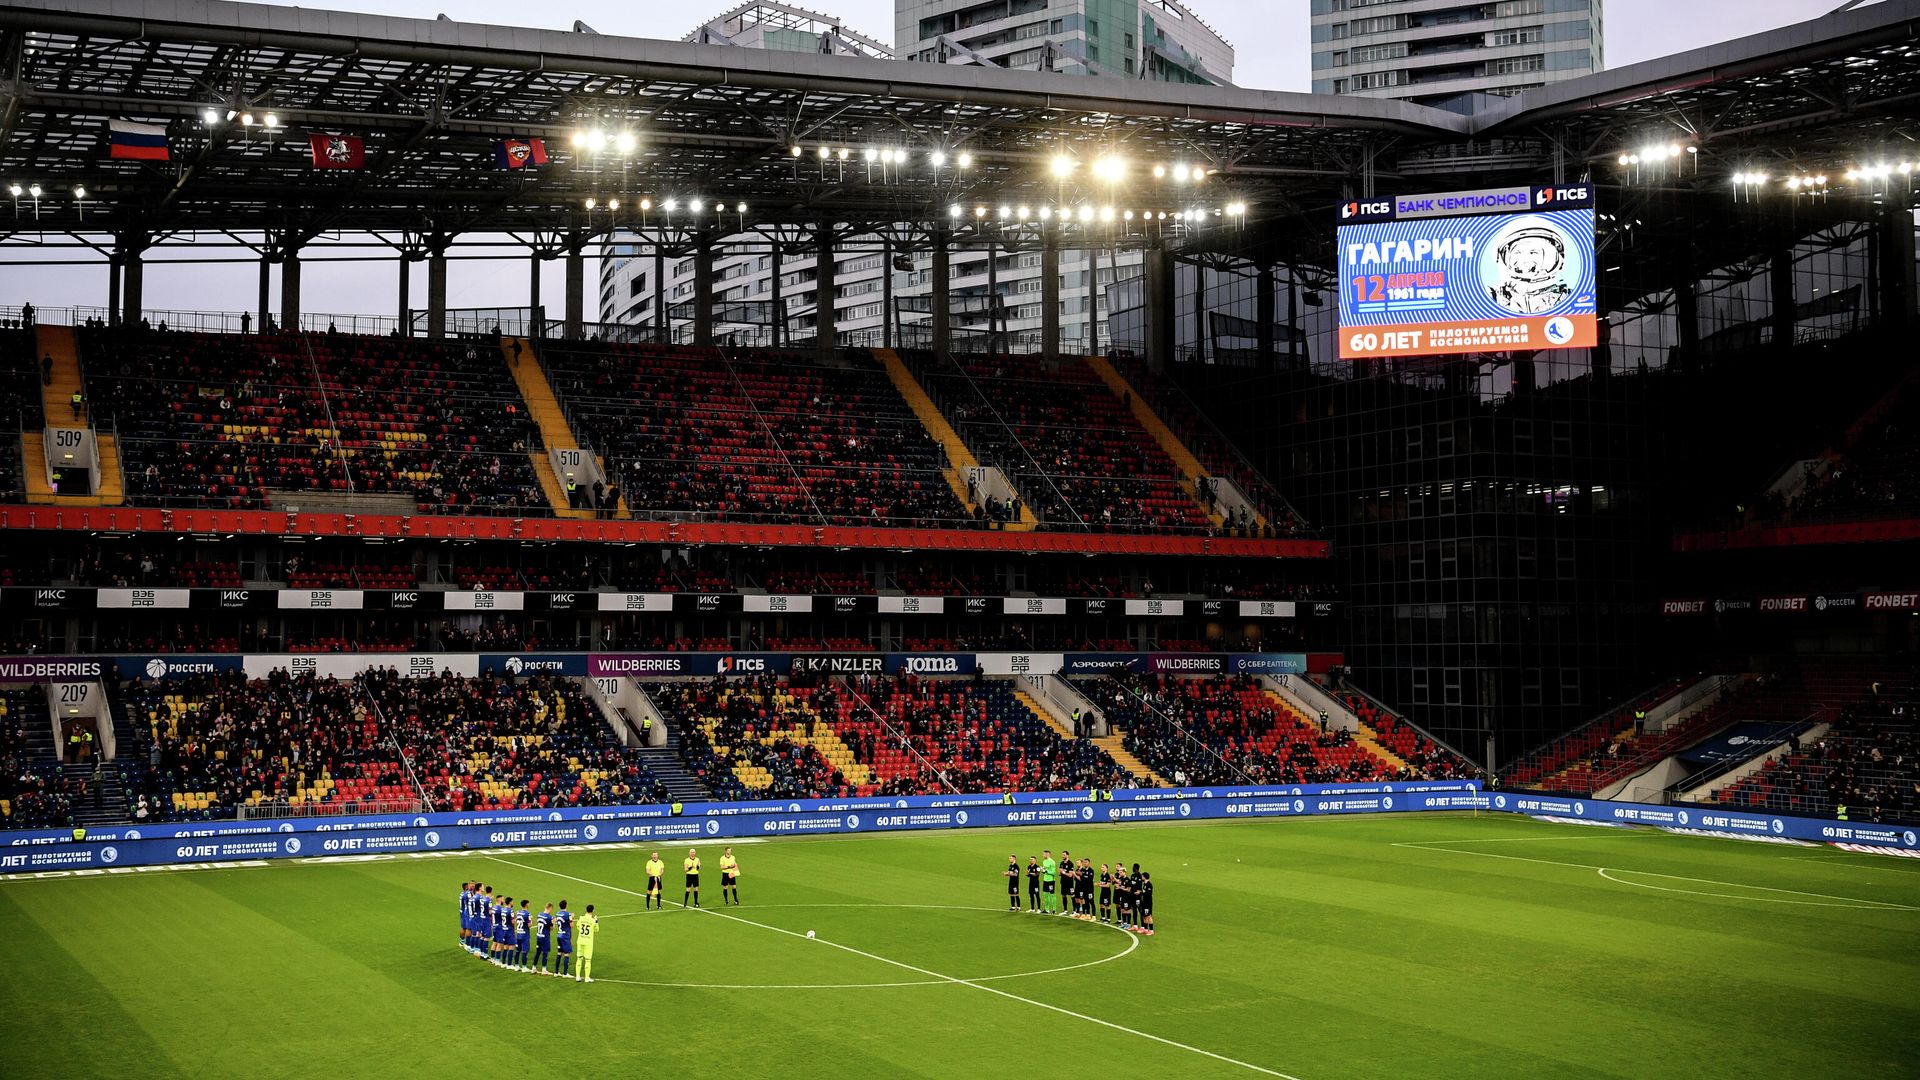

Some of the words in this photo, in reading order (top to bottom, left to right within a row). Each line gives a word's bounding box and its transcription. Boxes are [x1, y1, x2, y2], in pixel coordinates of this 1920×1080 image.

[1556, 188, 1588, 201] ПСБ
[1360, 202, 1390, 215] ПСБ
[1398, 200, 1434, 213] БАНК
[1438, 193, 1527, 210] ЧЕМПИОНОВ
[1348, 236, 1474, 265] ГАГАРИН
[1387, 271, 1444, 288] АПРЕЛЯ
[1353, 275, 1385, 302] 12
[1387, 288, 1414, 300] 1961
[1416, 288, 1444, 300] года
[1430, 323, 1528, 338] ПИЛОТИРУЕМОЙ
[1350, 333, 1377, 351] 60
[1381, 331, 1422, 350] ЛЕТ
[1430, 334, 1528, 347] КОСМОНАВТИКИ
[57, 430, 81, 447] 509
[560, 451, 579, 466] 510
[38, 590, 66, 599] ИКС
[224, 591, 248, 600] ИКС
[1664, 601, 1704, 613] FONBET
[1760, 598, 1806, 610] FONBET
[1866, 595, 1917, 608] FONBET
[598, 659, 681, 671] WILDBERRIES
[736, 659, 764, 670] ПСБ
[1156, 659, 1220, 669] WILDBERRIES
[1267, 660, 1297, 668] ЕАПТЕКА
[598, 679, 618, 694] 210
[61, 684, 87, 702] 209
[1319, 802, 1328, 810] 60
[1329, 801, 1344, 809] ЛЕТ
[1426, 798, 1435, 806] 60
[1436, 798, 1449, 806] ЛЕТ
[1518, 800, 1526, 808] 60
[1527, 801, 1539, 810] ЛЕТ
[1109, 808, 1119, 817] 60
[1121, 808, 1136, 817] ЛЕТ
[1227, 804, 1236, 813] 60
[1238, 804, 1253, 812] ЛЕТ
[1615, 809, 1624, 817] 60
[1625, 810, 1639, 819] ЛЕТ
[877, 817, 888, 826] 60
[890, 816, 907, 825] ЛЕТ
[1008, 812, 1019, 821] 60
[1020, 812, 1036, 820] ЛЕТ
[1703, 816, 1712, 825] 60
[1714, 818, 1729, 827] ЛЕТ
[618, 827, 631, 836] 60
[632, 826, 652, 836] ЛЕТ
[764, 821, 776, 831] 60
[778, 820, 796, 830] ЛЕТ
[490, 832, 504, 842] 60
[506, 832, 527, 842] ЛЕТ
[1823, 827, 1834, 837] 60
[1835, 828, 1853, 838] ЛЕТ
[324, 840, 339, 850] 60
[341, 839, 363, 849] ЛЕТ
[32, 851, 91, 859] ПИЛОТИРУЕМОЙ
[177, 847, 193, 857] 60
[195, 846, 219, 856] ЛЕТ
[1, 855, 27, 866] ЛЕТ
[580, 924, 590, 935] 35
